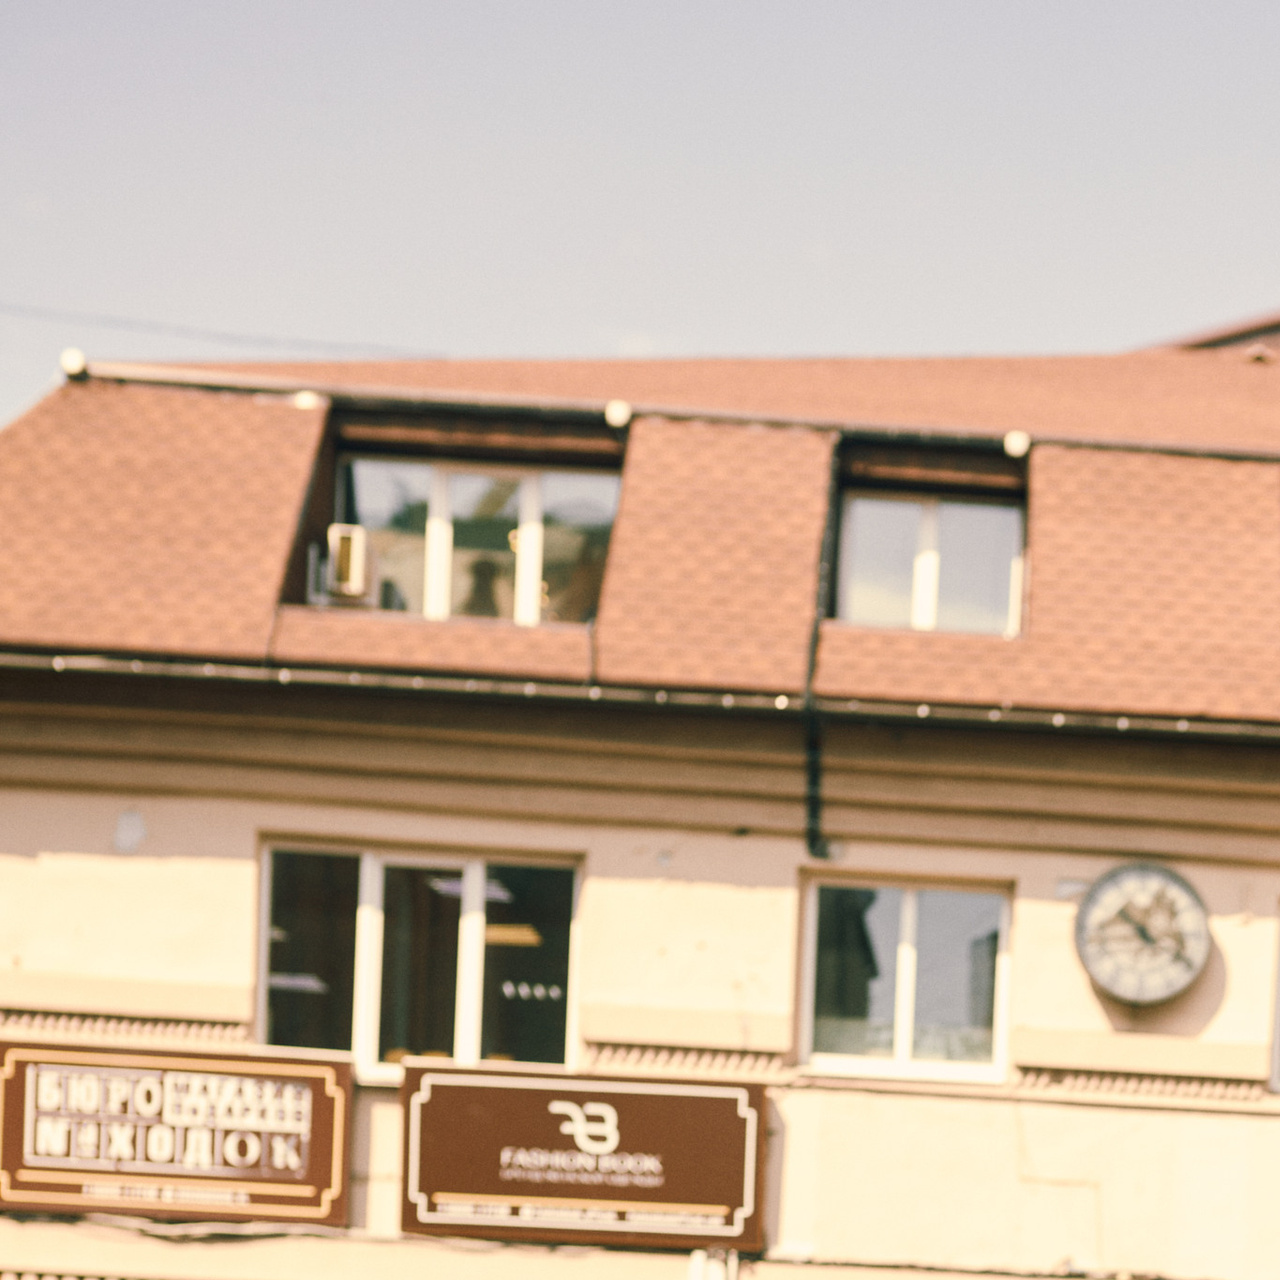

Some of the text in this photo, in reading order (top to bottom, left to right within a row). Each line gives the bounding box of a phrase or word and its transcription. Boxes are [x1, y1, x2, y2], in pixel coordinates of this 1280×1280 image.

[36, 1071, 163, 1117] БЮРО
[500, 1147, 664, 1174] FASHION BOOK
